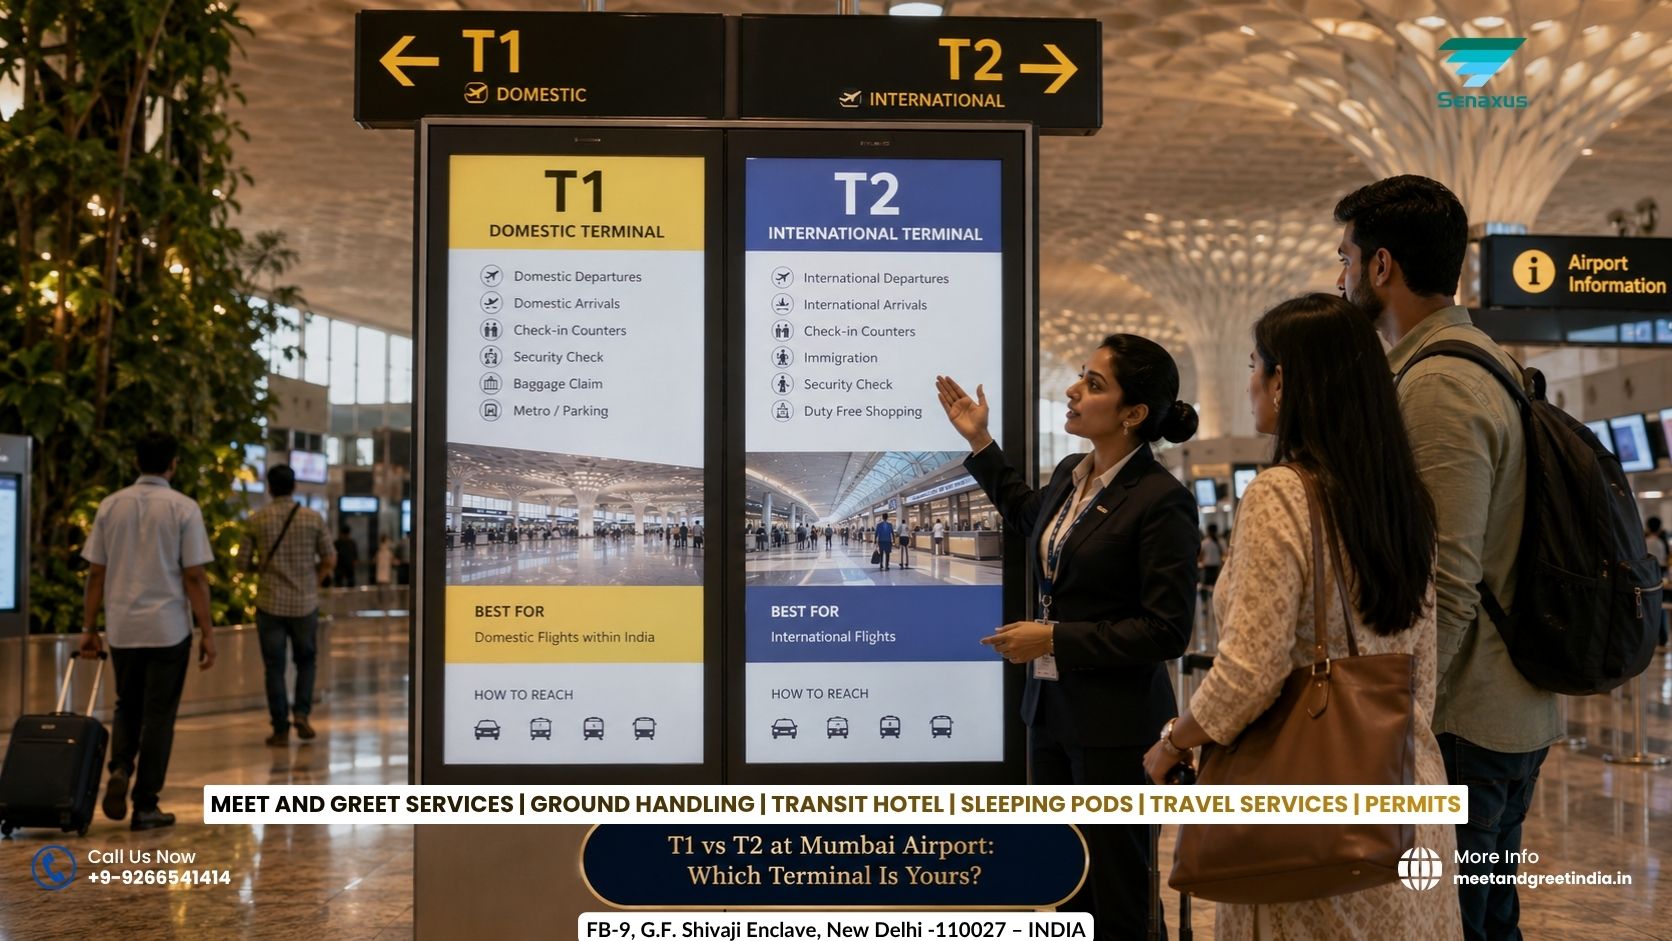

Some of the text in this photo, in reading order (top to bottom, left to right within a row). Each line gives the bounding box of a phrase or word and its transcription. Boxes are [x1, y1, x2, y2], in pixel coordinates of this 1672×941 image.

[462, 29, 520, 73] T1
[938, 38, 1003, 81] T2
[497, 87, 587, 103] DOMESTIC
[870, 92, 1005, 108] INTERNATIONAL
[545, 170, 602, 212] T1
[834, 172, 900, 216] T2
[490, 224, 665, 239] DOMESTIC TERMINAL
[768, 226, 983, 241] INTERNATIONAL TERMINAL
[1568, 254, 1629, 274] Airport
[514, 271, 642, 285] Domestic Departures
[804, 273, 949, 286] International Departures
[1569, 276, 1667, 294] Information
[514, 298, 620, 309] Domestic Arrivals
[804, 299, 928, 311] International Arrivals
[513, 325, 627, 336] Check-in Counters
[804, 326, 916, 337] Check-in Counters
[513, 352, 604, 365] Security Check
[804, 353, 878, 366] Immigration
[513, 378, 603, 392] Baggage Claim
[804, 379, 893, 392] Security Check
[513, 405, 609, 419] Metro / Parking
[804, 406, 922, 419] Duty Free Shopping
[475, 605, 545, 617] BEST FOR
[771, 605, 839, 618] BEST FOR
[475, 631, 655, 645] Domestic Flights within India
[771, 630, 896, 645] International Flights
[475, 689, 574, 700] HOW TO REACH
[771, 688, 869, 700] HOW TO REACH
